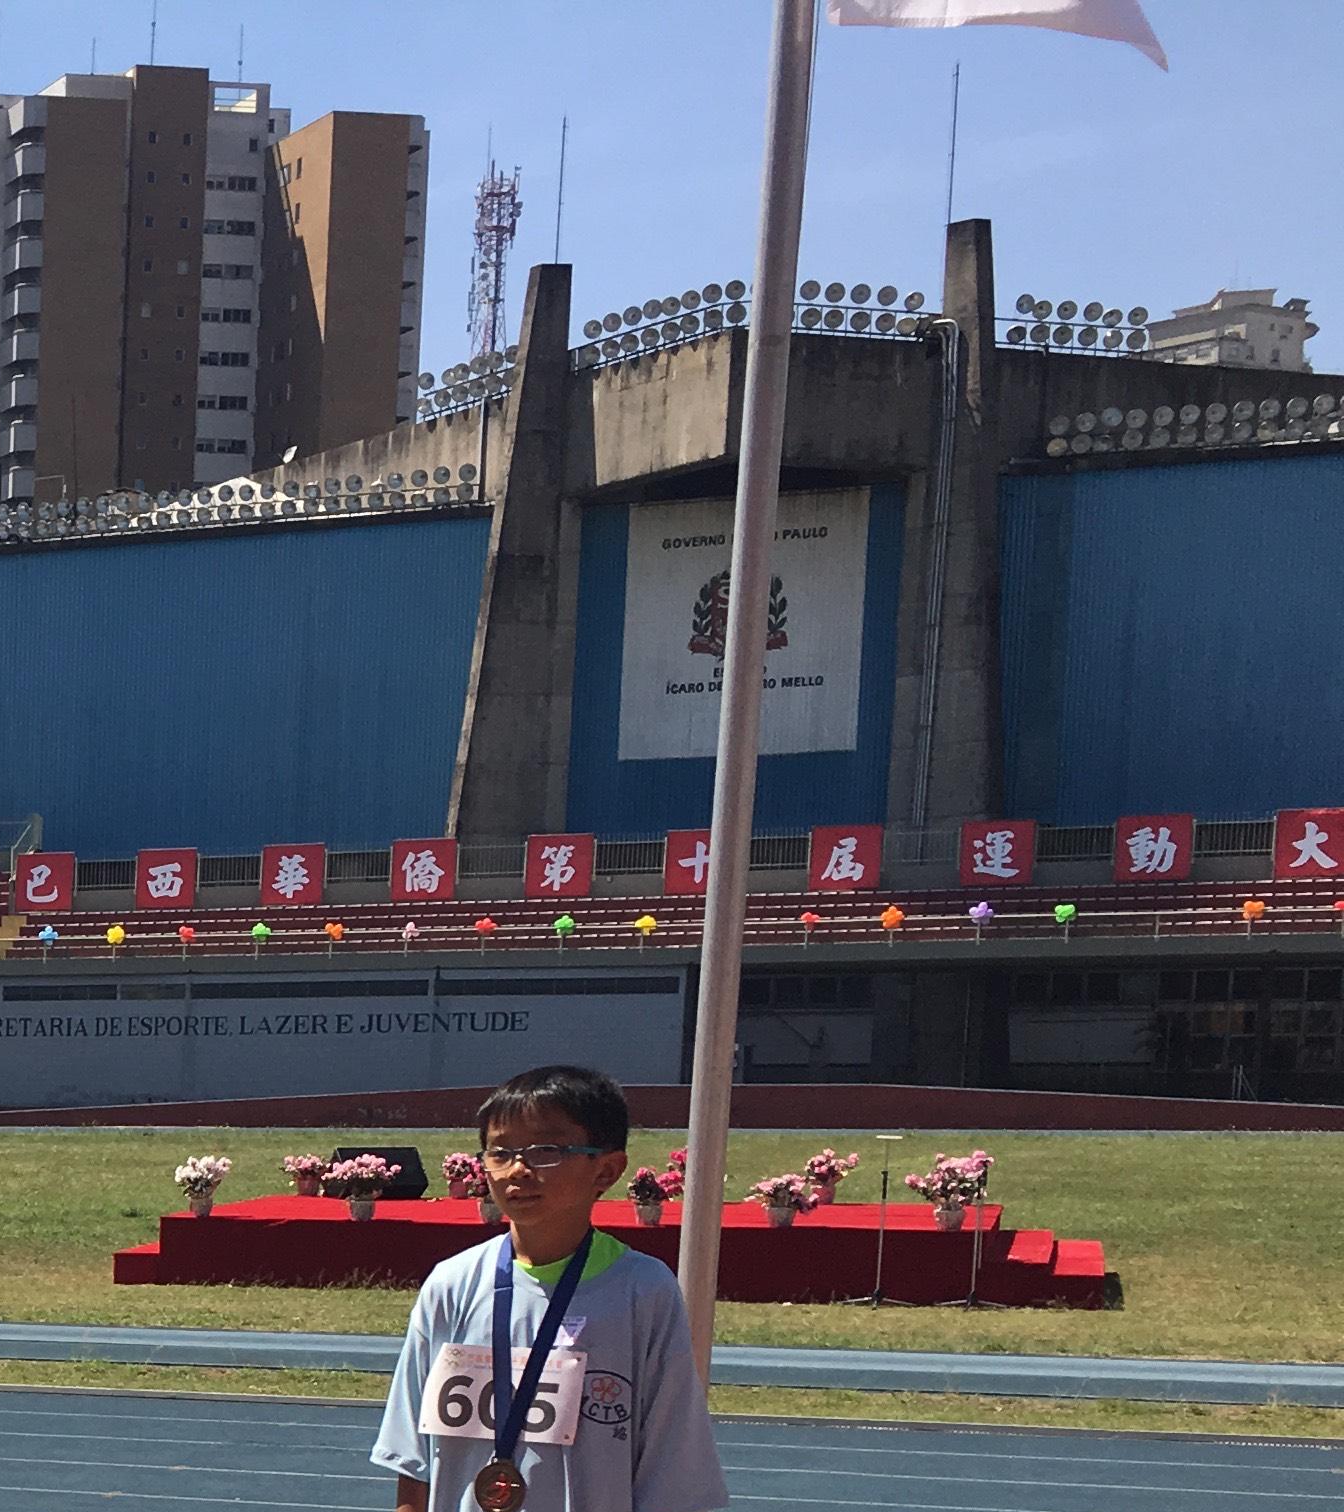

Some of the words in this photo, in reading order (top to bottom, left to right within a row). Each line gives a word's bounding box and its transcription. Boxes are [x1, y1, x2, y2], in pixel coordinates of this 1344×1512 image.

[662, 534, 726, 550] GOVERNO
[782, 527, 828, 540] PAULO
[781, 675, 824, 688] MELLO
[26, 864, 58, 903] 巴
[146, 862, 183, 898] 西
[272, 854, 309, 899] 華
[402, 850, 445, 893] 僑
[540, 844, 576, 891] 第
[973, 830, 1020, 878] 運
[1126, 826, 1177, 873] 動
[1289, 821, 1338, 869] 大
[94, 1017, 122, 1038] DE
[127, 1016, 233, 1038] ESPORTE,
[239, 1014, 329, 1036] LAZER
[335, 1013, 354, 1034] E
[360, 1011, 530, 1034] JUVENTUDE
[588, 1402, 628, 1420] CTB
